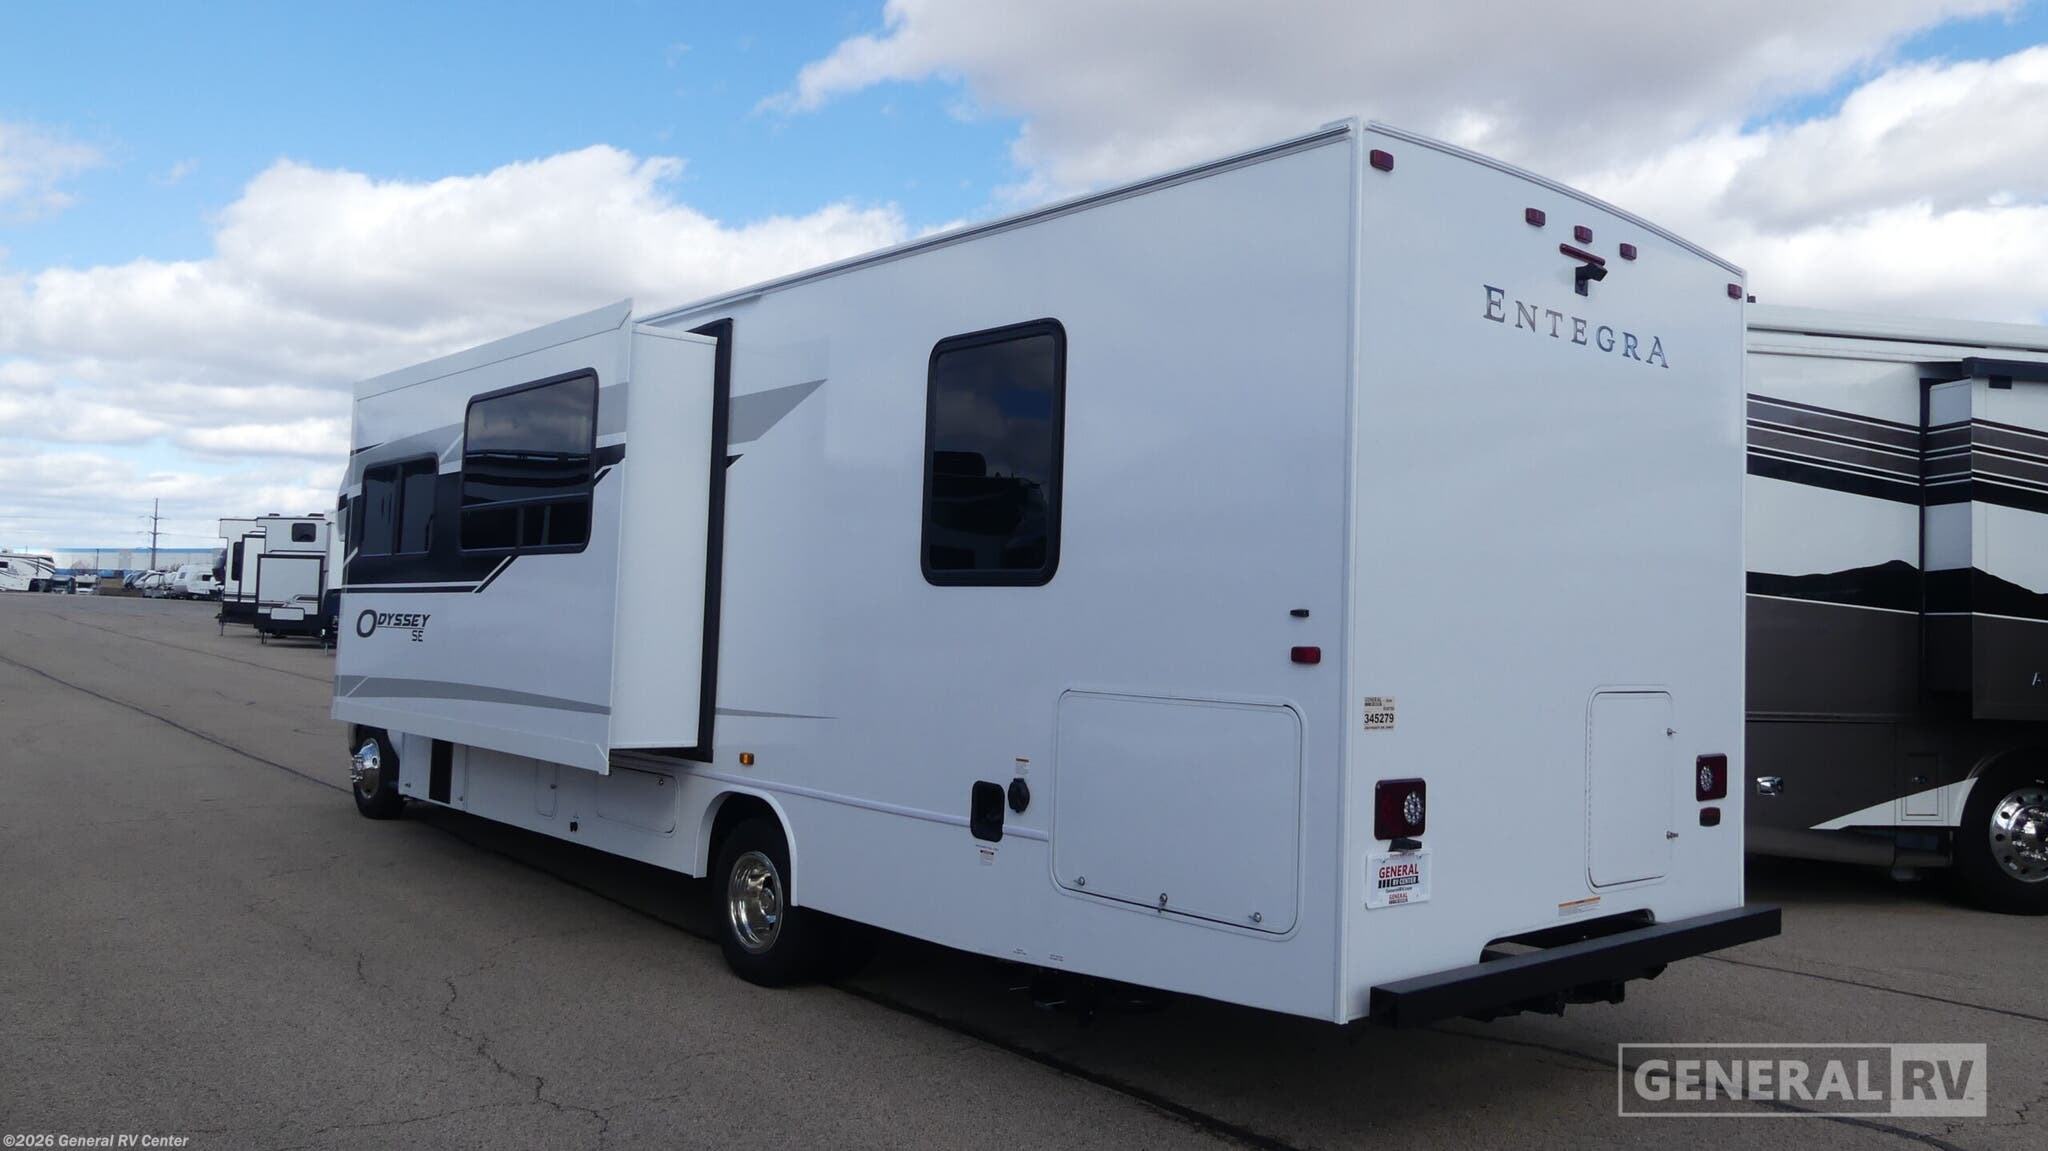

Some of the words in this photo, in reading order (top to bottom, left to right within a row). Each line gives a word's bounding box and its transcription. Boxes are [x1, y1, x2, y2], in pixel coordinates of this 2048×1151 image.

[1483, 284, 1670, 369] ENTEGRA
[356, 609, 431, 638] ODYSSEY
[411, 630, 424, 642] SE
[1364, 713, 1394, 724] 345279
[1379, 863, 1419, 879] GENERAL
